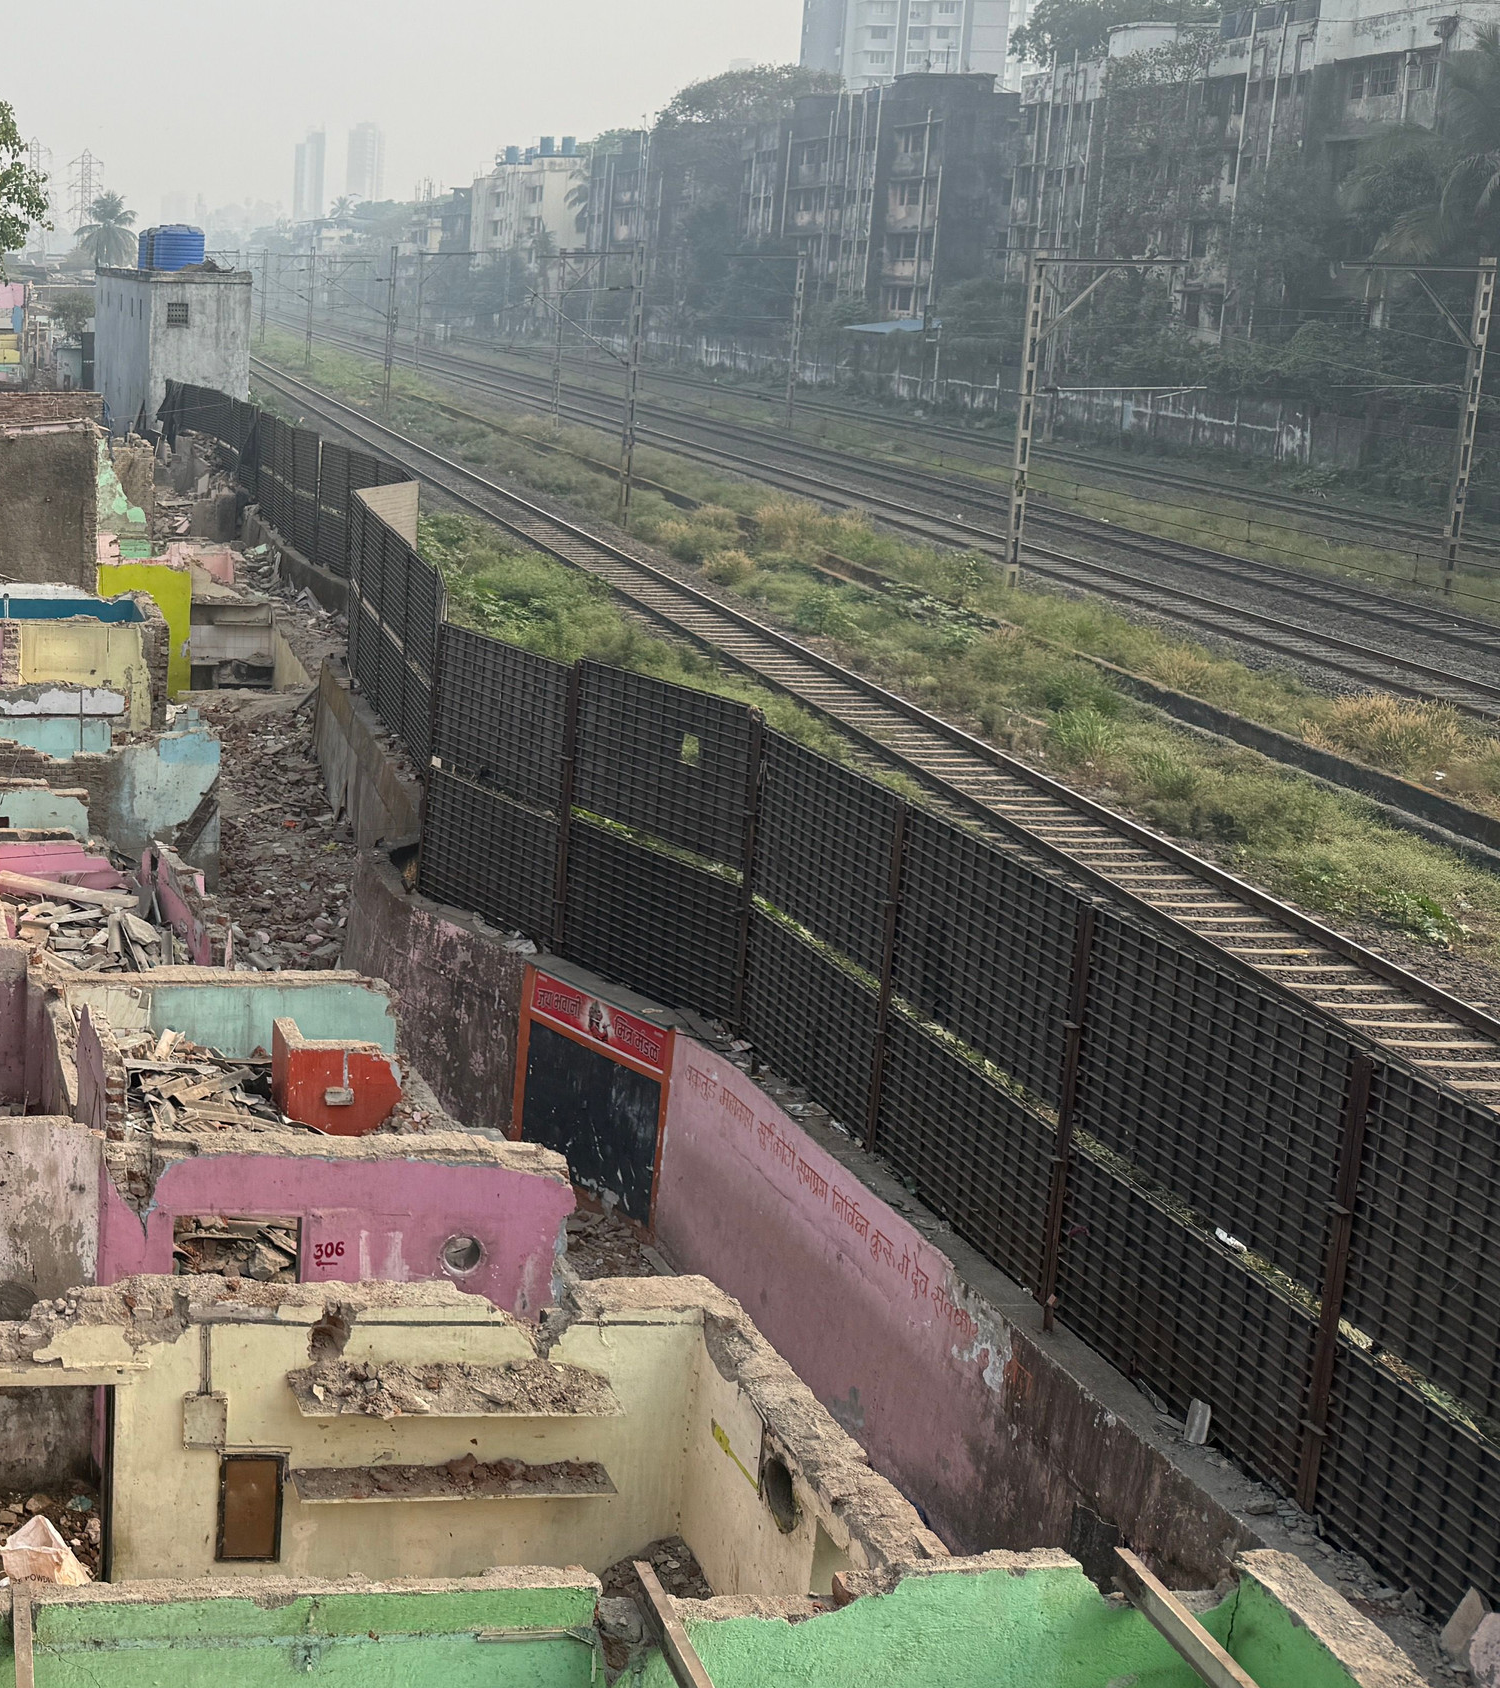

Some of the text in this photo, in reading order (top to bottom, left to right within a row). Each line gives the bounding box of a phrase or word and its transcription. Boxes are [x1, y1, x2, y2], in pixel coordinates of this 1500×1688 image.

[537, 988, 554, 1010] जय
[553, 993, 582, 1018] भवानी
[614, 1014, 634, 1045] मित्र
[313, 1241, 345, 1260] 306
